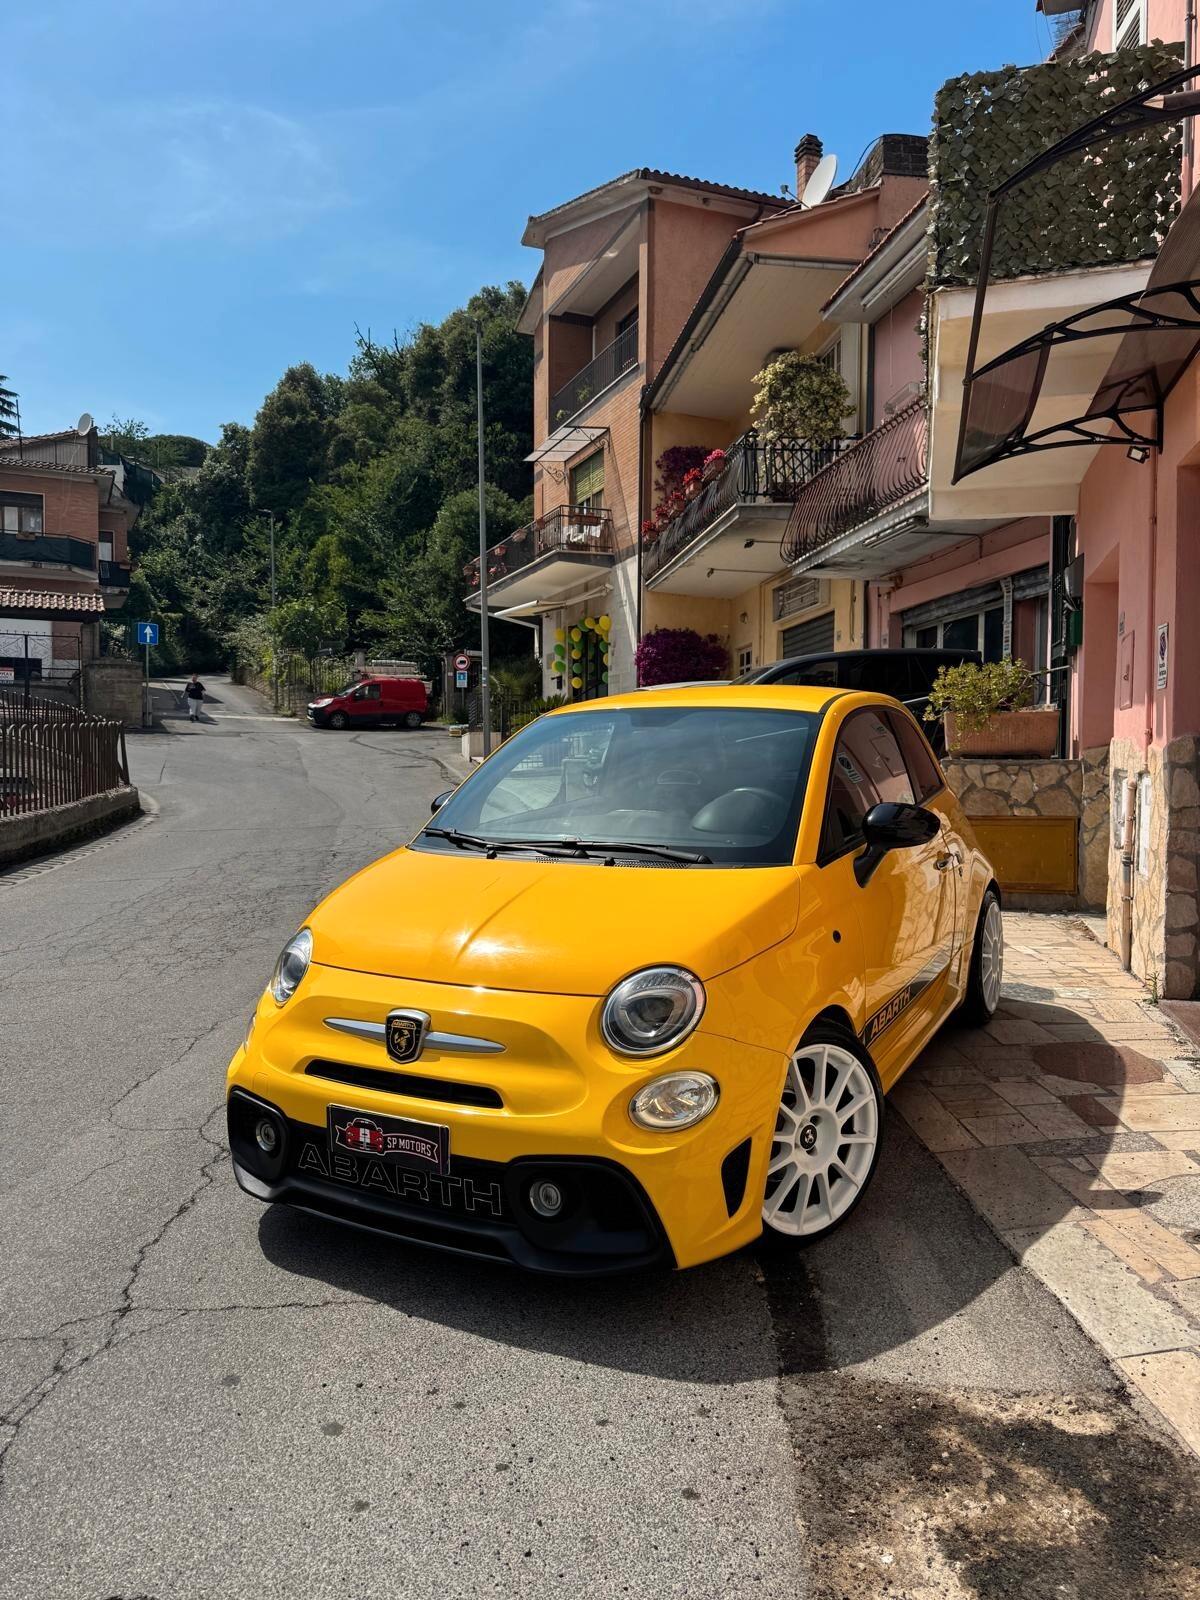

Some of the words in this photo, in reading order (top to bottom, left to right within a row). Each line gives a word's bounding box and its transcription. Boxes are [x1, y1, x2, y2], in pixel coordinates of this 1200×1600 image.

[870, 985, 911, 1039] ABARTH
[387, 1137, 397, 1148] SP
[398, 1138, 431, 1157] MOTORS
[298, 1142, 502, 1216] ABARTH
